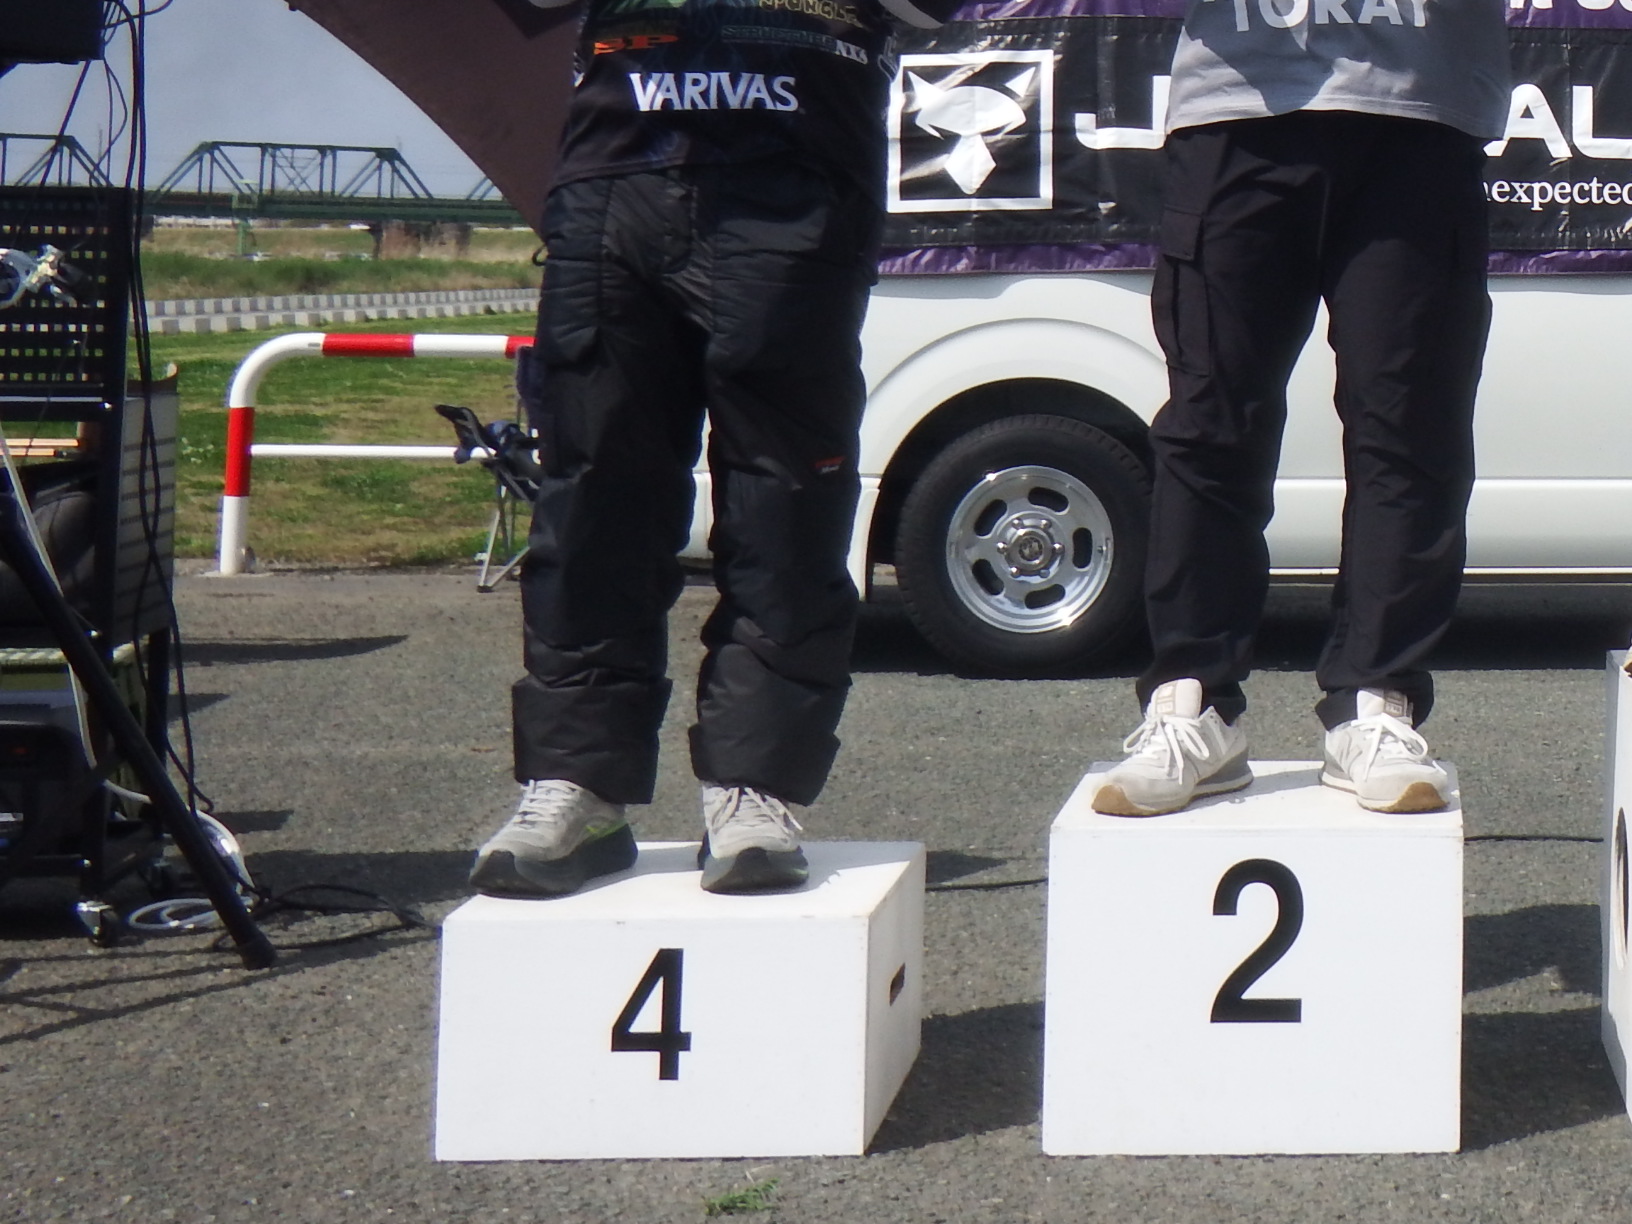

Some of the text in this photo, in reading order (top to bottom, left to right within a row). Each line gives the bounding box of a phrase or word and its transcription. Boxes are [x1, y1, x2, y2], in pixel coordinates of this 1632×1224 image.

[629, 71, 799, 112] VARIVAS
[1209, 857, 1305, 1024] 2
[610, 947, 692, 1081] 4
